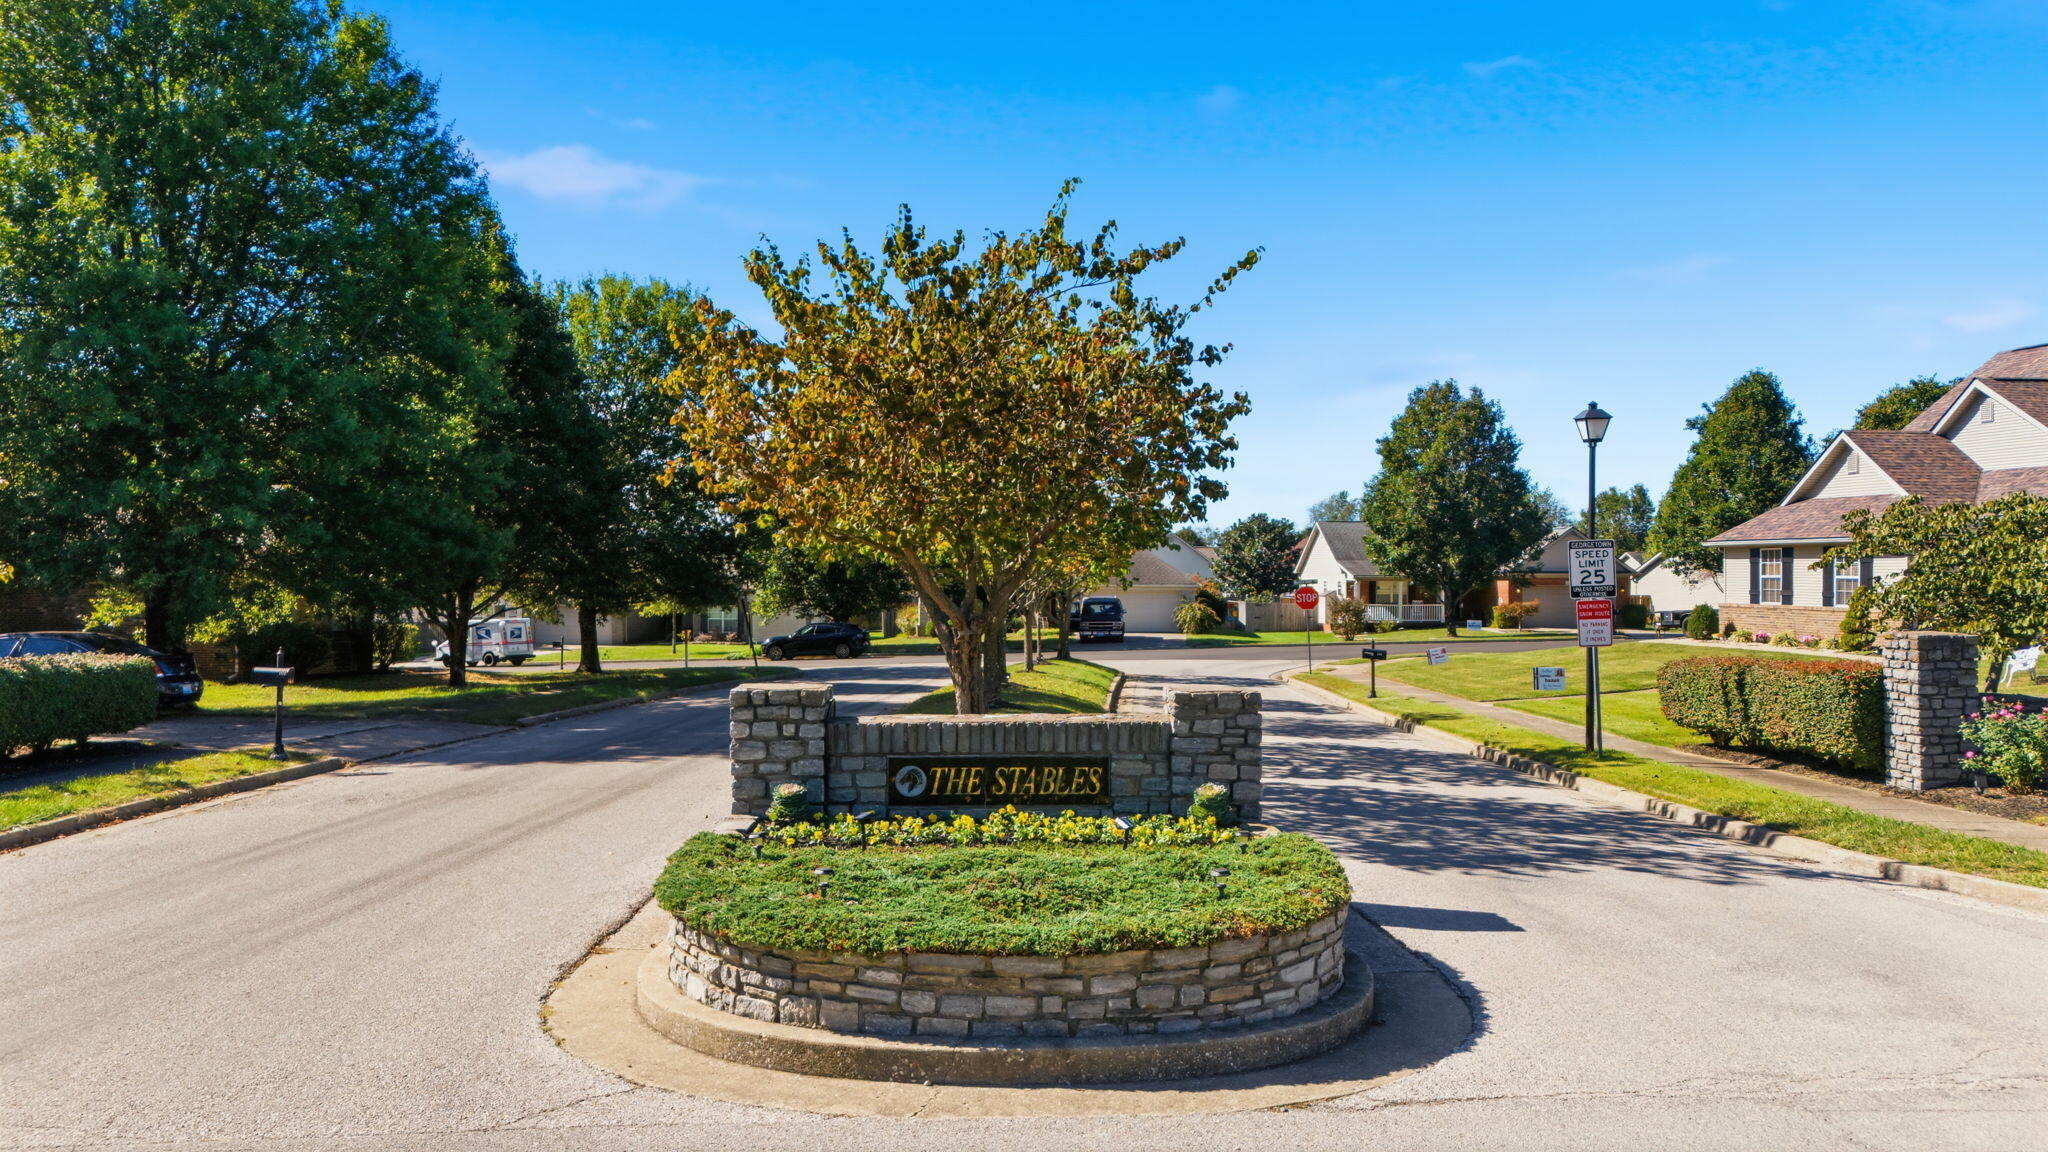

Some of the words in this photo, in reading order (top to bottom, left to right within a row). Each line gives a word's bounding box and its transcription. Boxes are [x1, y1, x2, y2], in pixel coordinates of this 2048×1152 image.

[1575, 550, 1609, 558] SPEED
[1579, 560, 1605, 568] LIMIT
[1580, 570, 1606, 584] 25
[1296, 593, 1318, 603] STOP
[929, 766, 984, 796] THE
[992, 766, 1102, 796] STABLES
